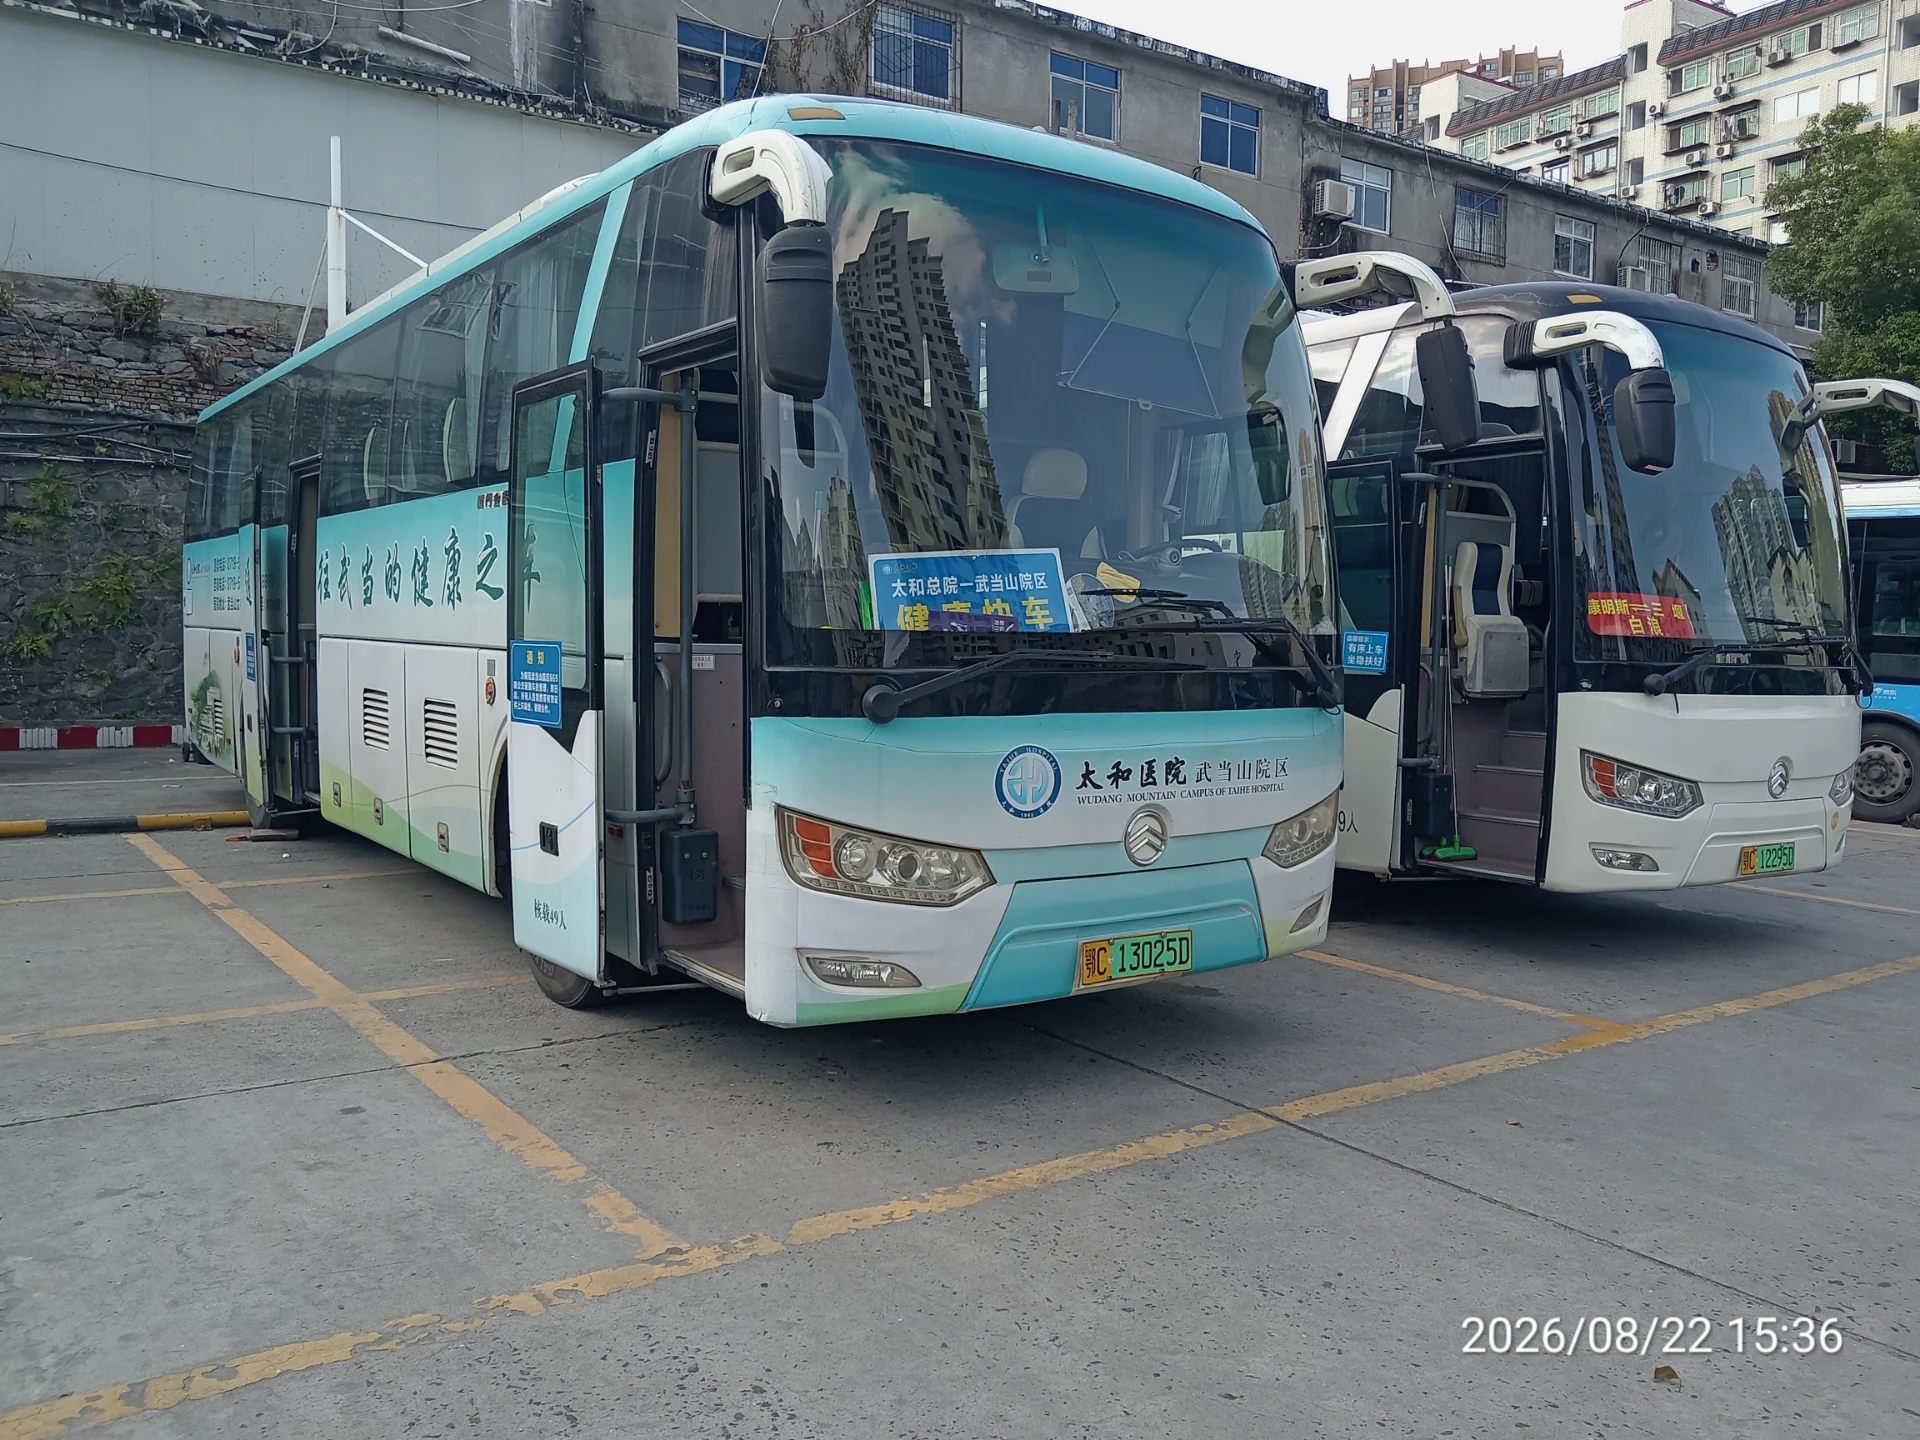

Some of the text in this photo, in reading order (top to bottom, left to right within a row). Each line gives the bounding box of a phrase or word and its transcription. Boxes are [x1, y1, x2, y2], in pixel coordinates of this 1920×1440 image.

[1628, 615, 1664, 636] 白浪
[1347, 655, 1383, 667] 坐稳扶好
[1348, 643, 1383, 655] 有序上车
[1025, 747, 1058, 773] HOSPITAL
[1075, 756, 1289, 791] 太和医院 武当山院区
[1077, 782, 1286, 806] WUDANG MOUNTAIN CAMPUS OF TAIHE HOSPITAL
[533, 898, 567, 930] 核载49人
